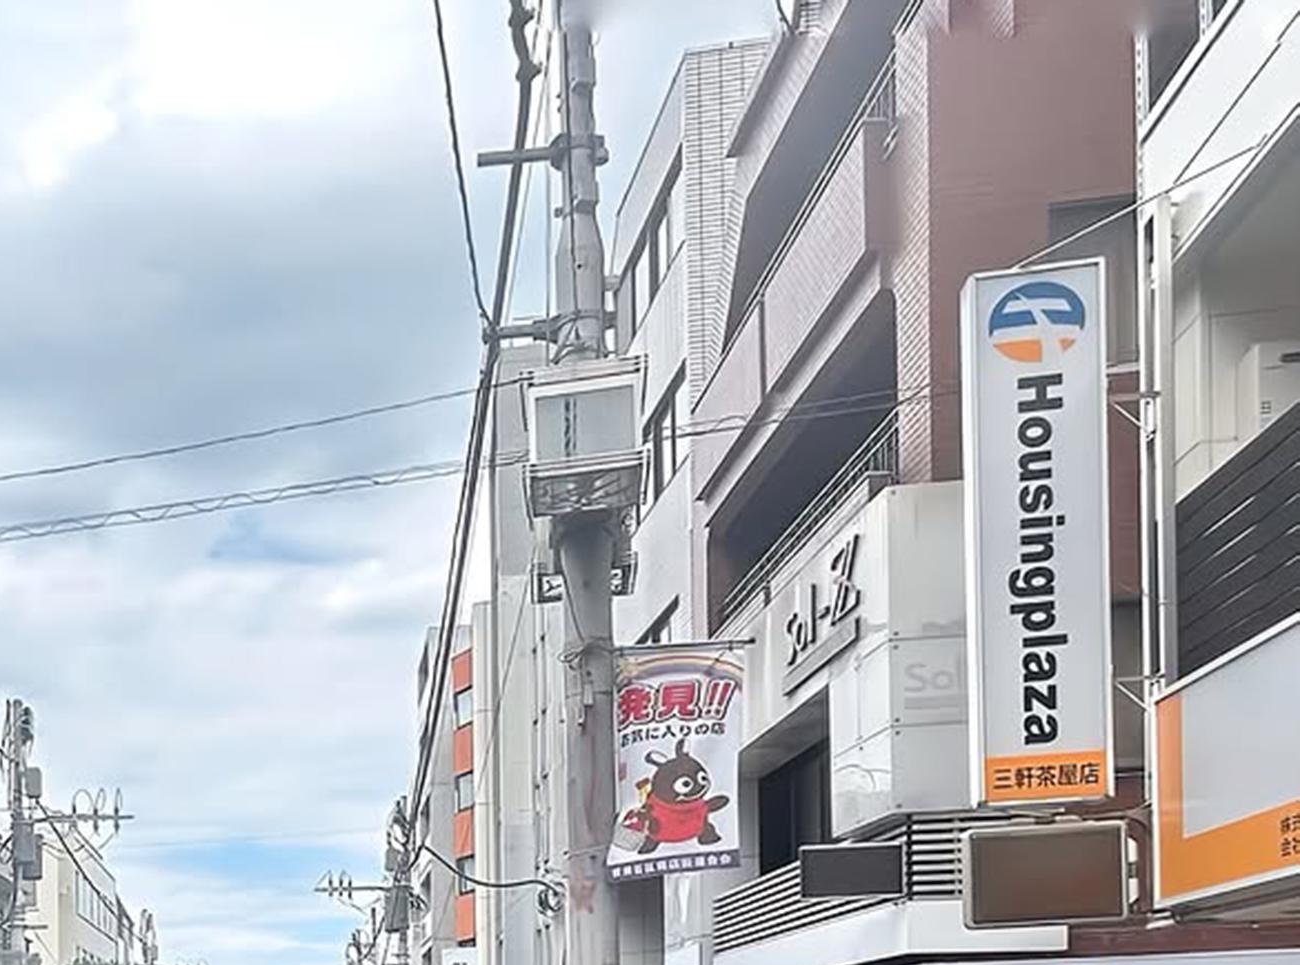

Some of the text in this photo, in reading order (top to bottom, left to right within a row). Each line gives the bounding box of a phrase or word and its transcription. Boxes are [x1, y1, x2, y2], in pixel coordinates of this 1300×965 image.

[1008, 373, 1069, 746] Housingplaza
[993, 762, 1100, 789] 三軒茶屋店
